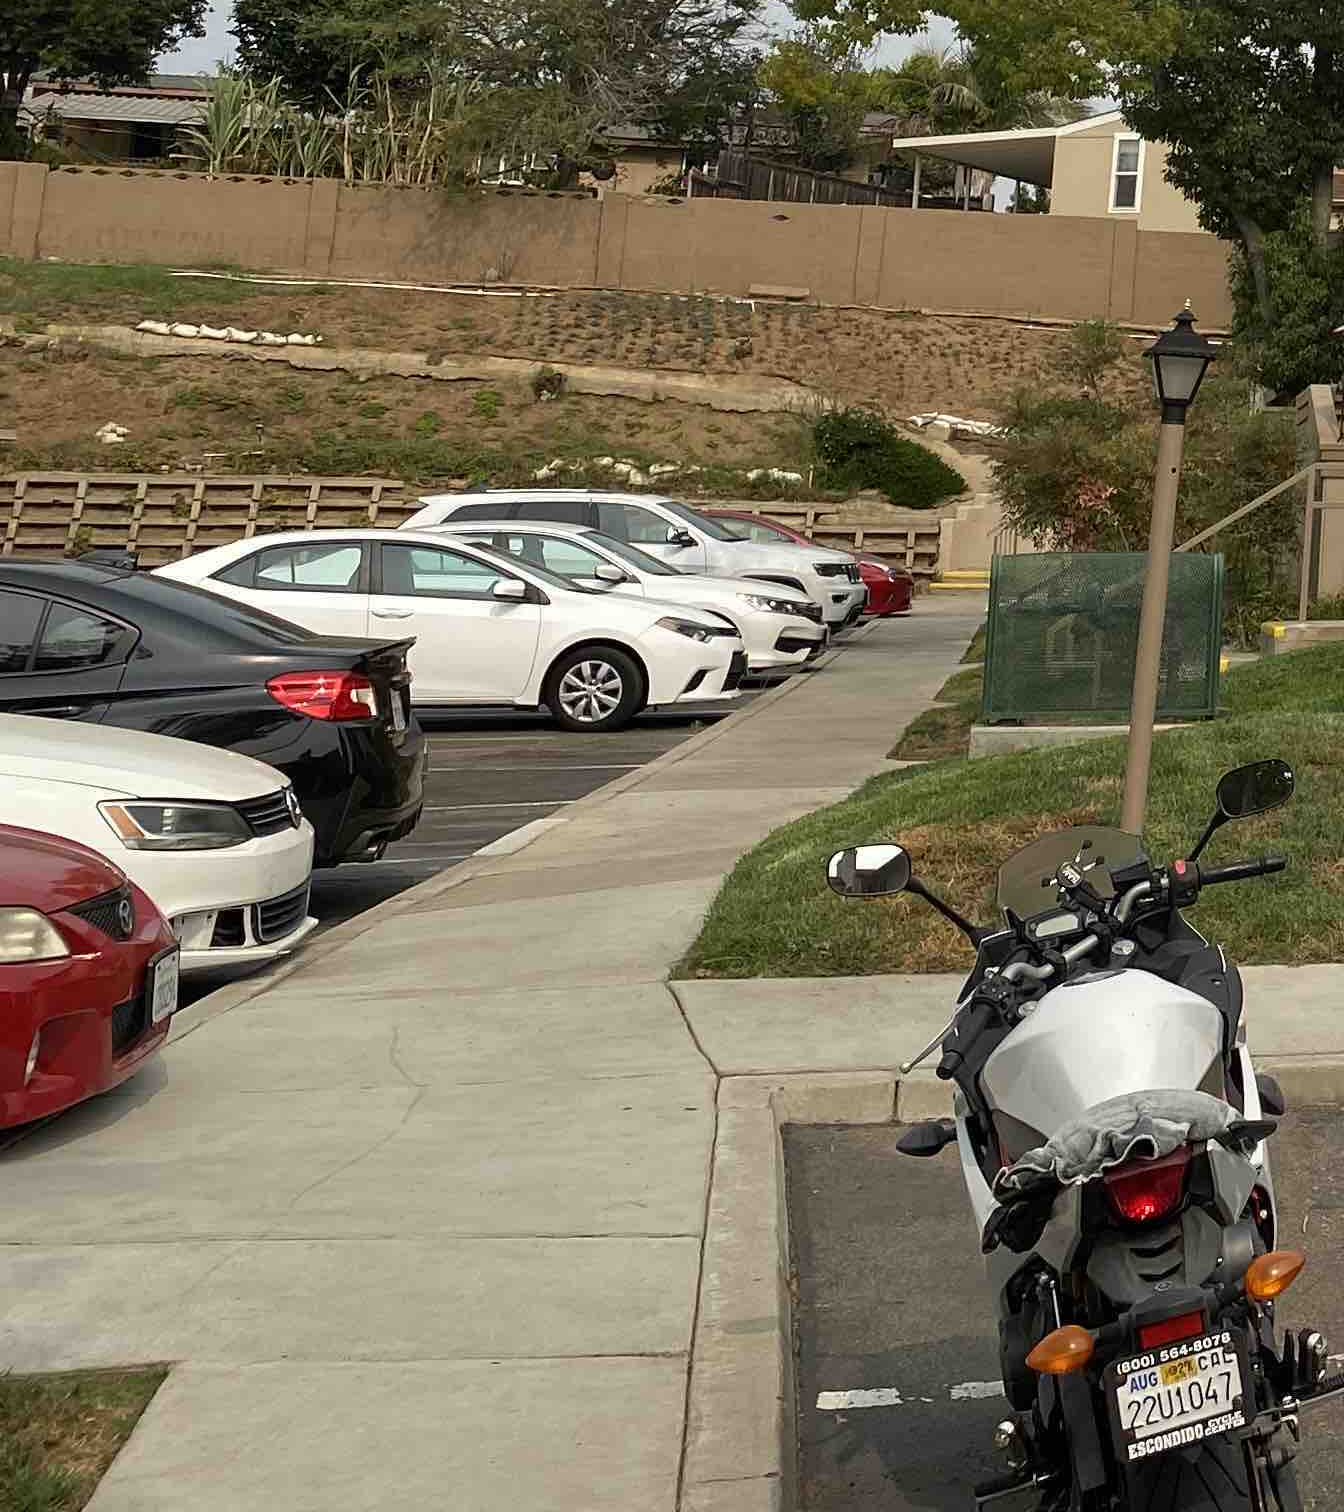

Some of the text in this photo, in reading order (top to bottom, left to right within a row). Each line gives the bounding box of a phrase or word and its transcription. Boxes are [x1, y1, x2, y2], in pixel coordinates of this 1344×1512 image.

[1116, 1354, 1155, 1375] (800)
[1160, 1332, 1231, 1363] 564-8078
[1127, 1371, 1232, 1430] 22U1047
[1130, 1372, 1158, 1393] AUG
[1127, 1423, 1204, 1460] ESCONDIDO
